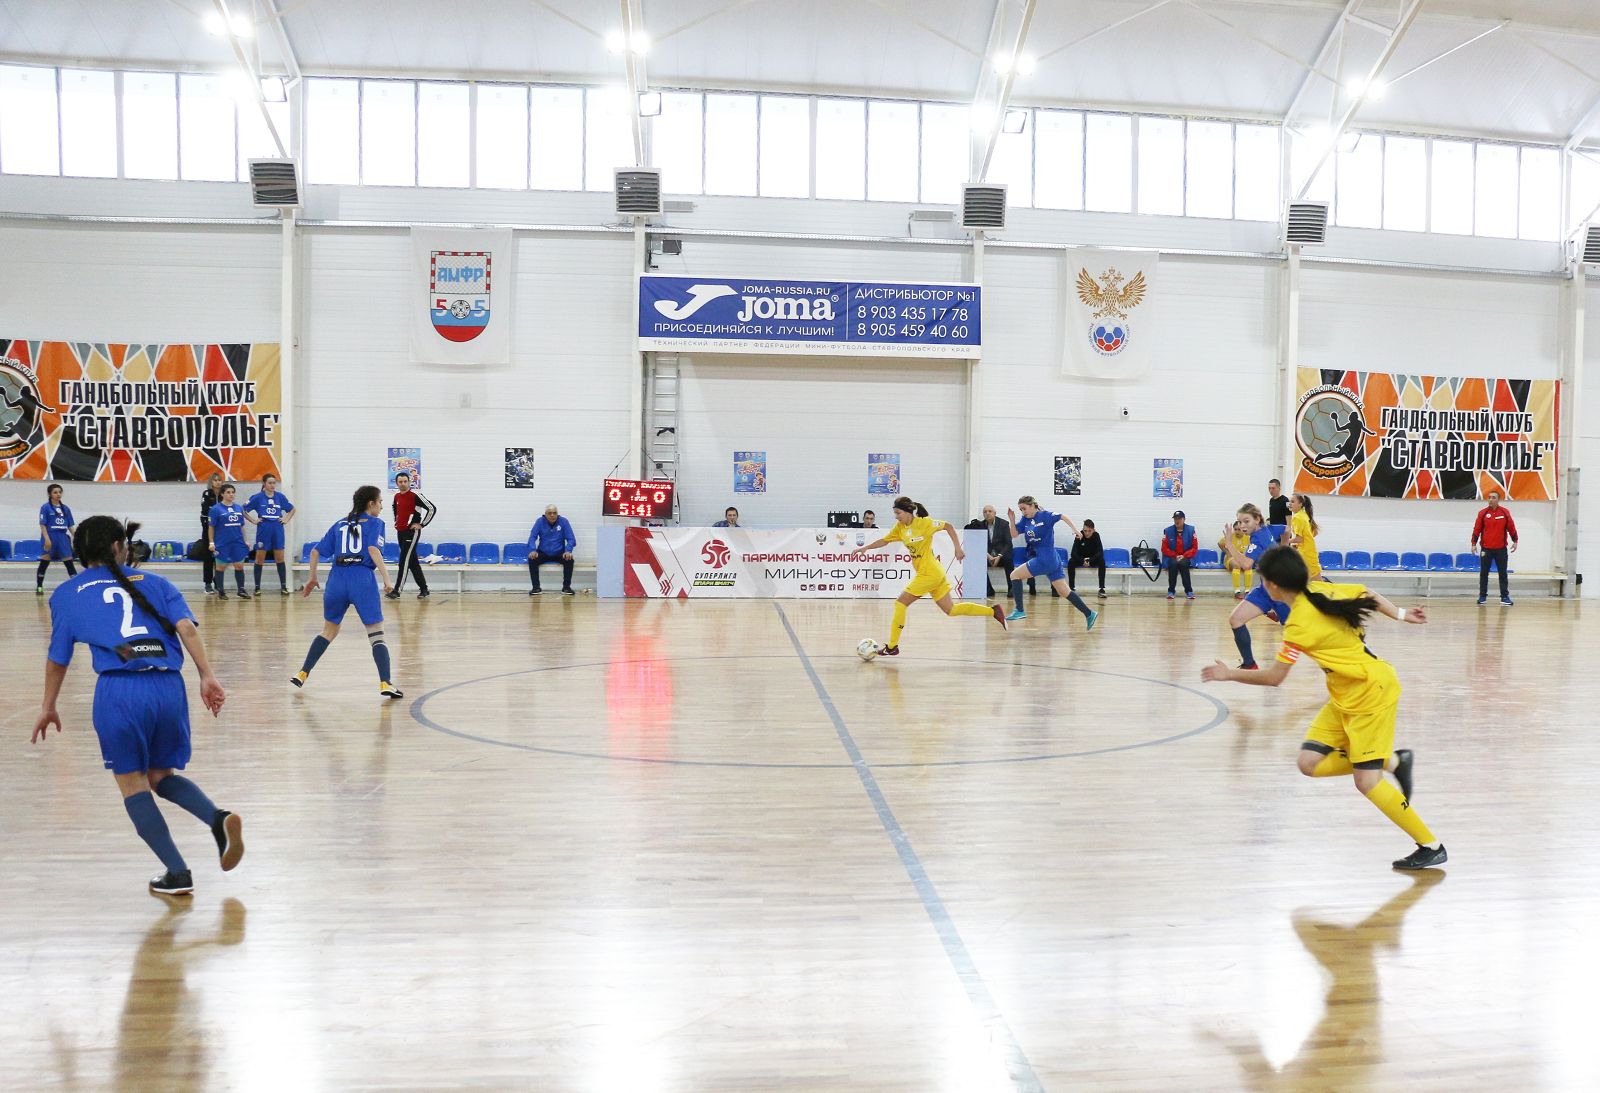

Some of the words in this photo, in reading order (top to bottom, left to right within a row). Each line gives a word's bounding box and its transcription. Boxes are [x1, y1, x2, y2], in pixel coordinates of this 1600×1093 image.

[742, 285, 831, 296] JOMA-RUSSIA.RU
[855, 288, 953, 301] ДИСТРИБЬЮТОР
[957, 291, 975, 302] №1
[435, 299, 448, 317] 5
[474, 300, 486, 318] 5
[857, 306, 866, 319] 8
[871, 306, 896, 320] 903
[901, 308, 926, 321] 435
[932, 308, 947, 321] 17
[952, 309, 968, 321] 78
[654, 323, 762, 335] ПРИСОЕДИНЯЙСЯ
[765, 326, 773, 335] К
[776, 326, 835, 336] ЛУЧШИМ!
[857, 323, 866, 336] 8
[871, 324, 896, 337] 905
[901, 325, 926, 338] 459
[930, 325, 947, 338] 40
[952, 326, 968, 338] 60
[753, 342, 800, 350] ФЕДЕРАЦИИ
[872, 345, 946, 353] СТАВРОПОЛЬСКОГО
[60, 379, 199, 408] ГАНДБОЛЬНЫЙ
[207, 382, 255, 404] КЛУБ
[1381, 408, 1489, 432] ГАНДБОЛЬНЫЙ
[1495, 413, 1533, 432] КЛУБ
[1381, 438, 1555, 470] "СТАВРОПОЛЬЕ"
[609, 489, 621, 500] 0
[654, 491, 665, 503] 0
[620, 503, 652, 516] 5:41
[830, 515, 836, 523] 1
[340, 524, 363, 554] 10
[742, 553, 809, 562] ПАРИМАТЧ
[818, 554, 888, 563] ЧЕМПИОНАТ
[765, 568, 911, 580] МИНИ-ФУТБОЛ
[102, 587, 148, 638] 2
